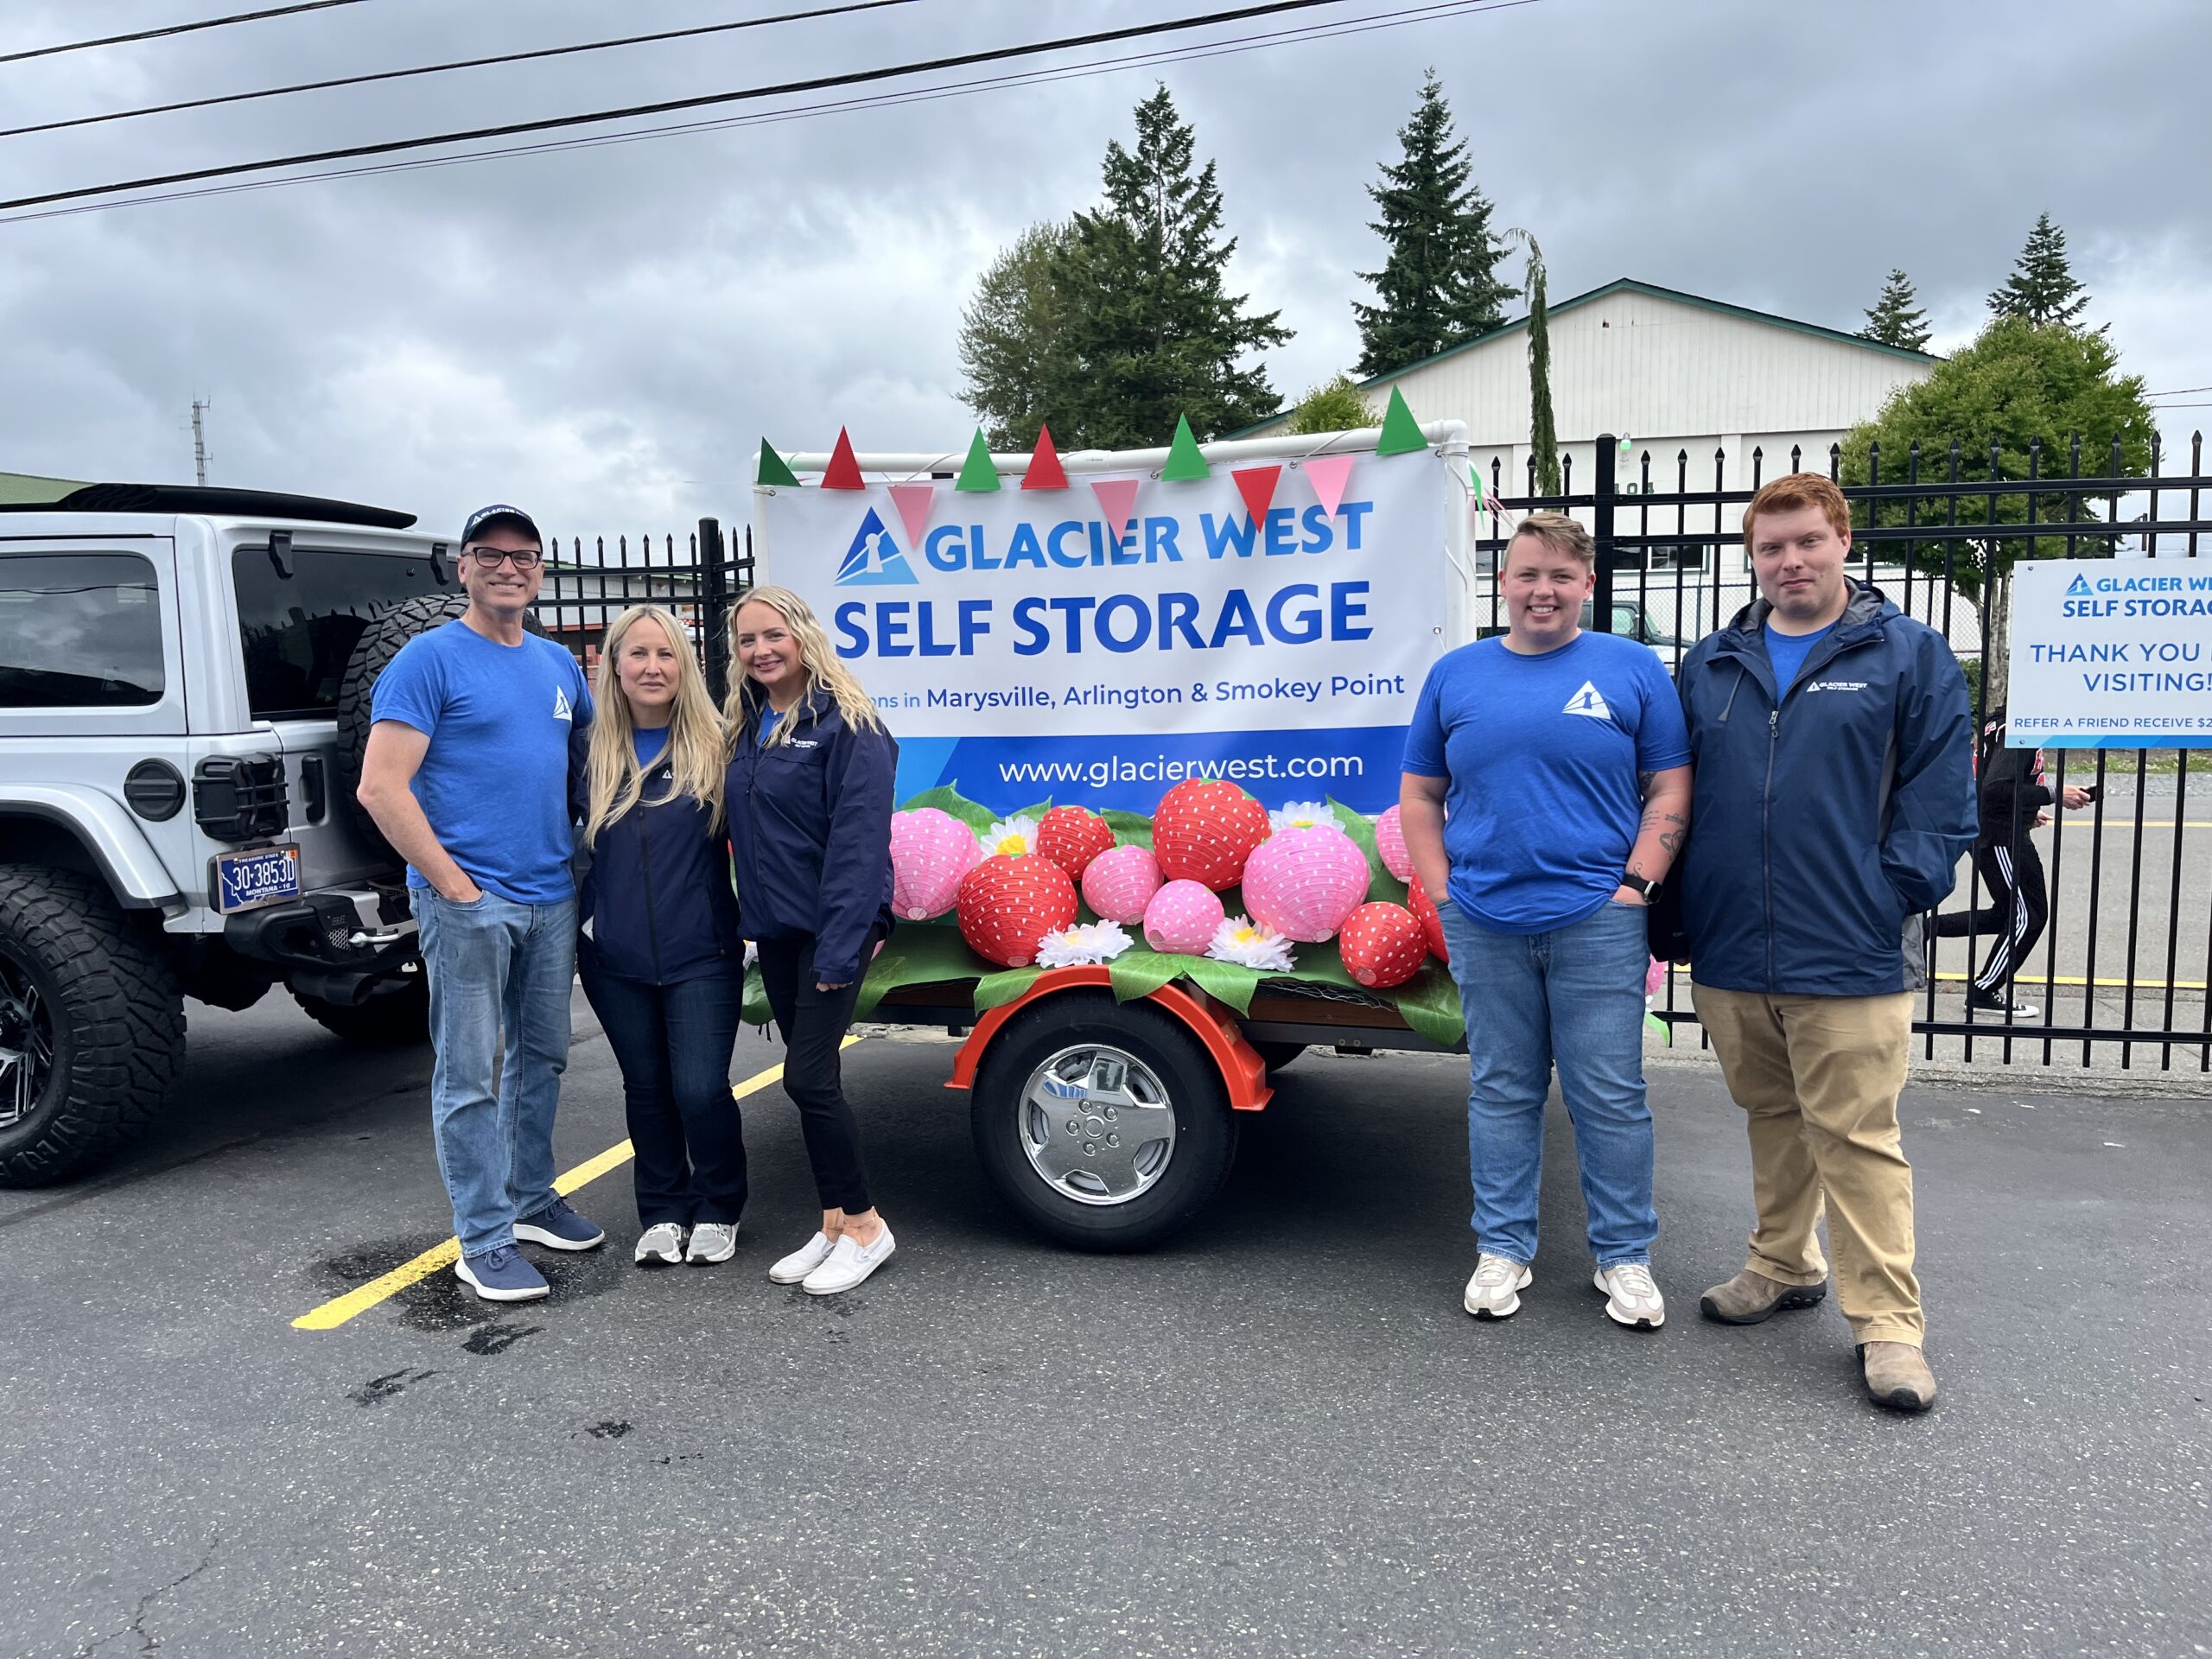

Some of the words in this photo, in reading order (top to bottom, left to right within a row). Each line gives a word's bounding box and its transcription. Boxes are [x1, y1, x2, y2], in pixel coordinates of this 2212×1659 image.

[925, 516, 1184, 573] GLACIER
[1198, 501, 1374, 560] WEST
[2096, 577, 2183, 593] GLACIER
[2063, 600, 2119, 618] SELF
[834, 599, 993, 659] SELF
[1013, 580, 1374, 657] STORAGE
[2031, 644, 2129, 663] THANK
[2139, 643, 2200, 662] YOU
[2083, 673, 2212, 692] VISITING!
[904, 692, 920, 708] in
[927, 686, 1056, 712] Marysville,
[1064, 683, 1182, 709] Arlington
[1191, 683, 1208, 702] &
[1216, 677, 1322, 702] Smokey
[1331, 673, 1405, 696] Point
[2014, 718, 2059, 728] REFER
[2063, 718, 2073, 728] A
[2078, 718, 2129, 728] FRIEND
[2133, 718, 2193, 728] RECEIVE
[999, 754, 1363, 788] www.glacierwest.com
[245, 886, 278, 896] MONTANA
